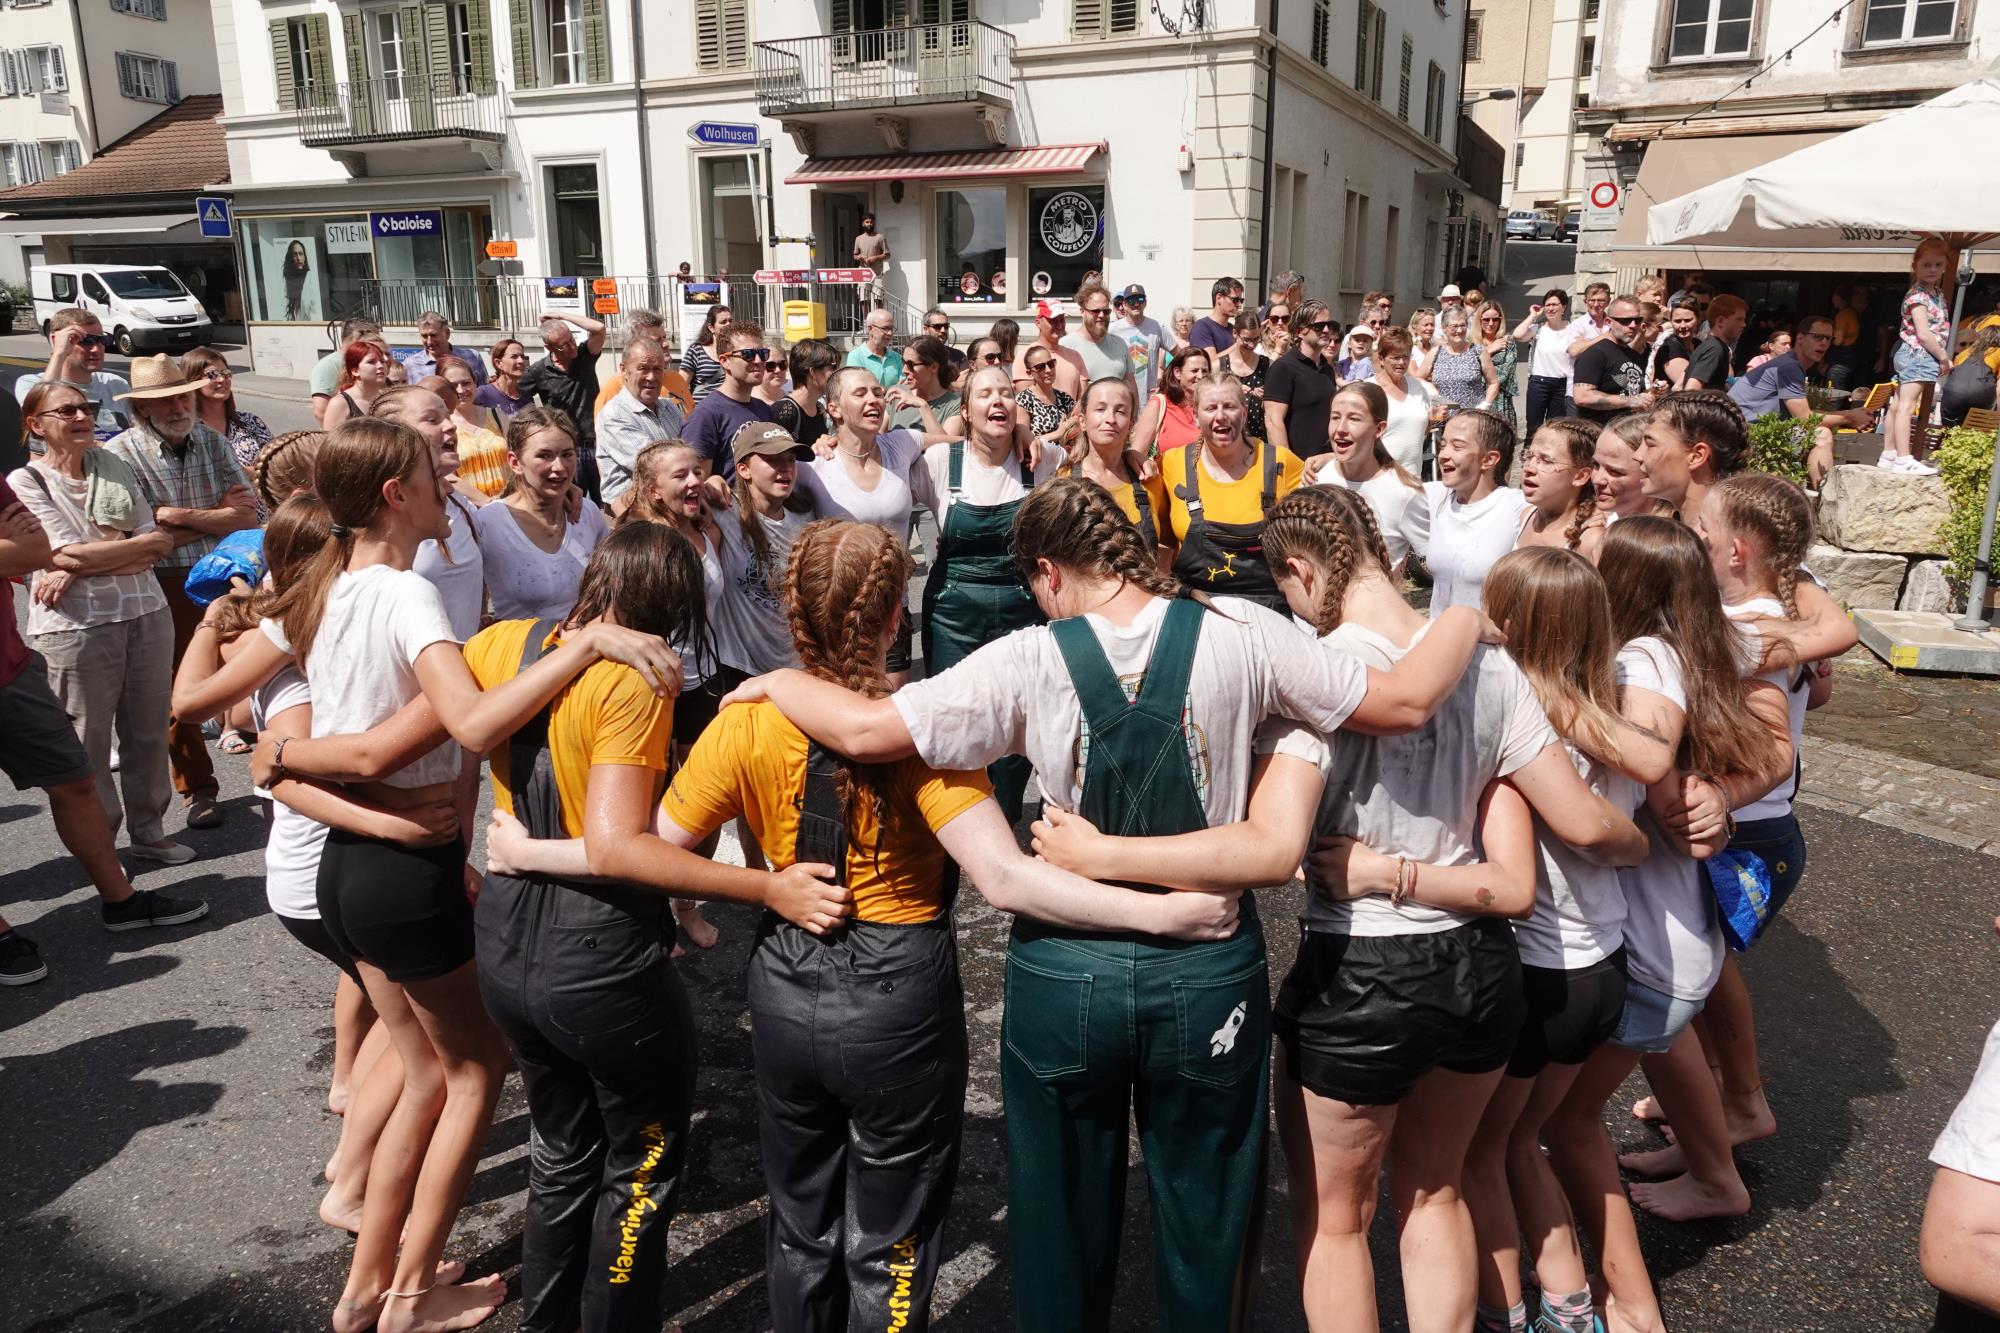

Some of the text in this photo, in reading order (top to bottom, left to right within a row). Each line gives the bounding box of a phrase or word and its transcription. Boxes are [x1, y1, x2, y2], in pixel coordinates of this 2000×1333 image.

[704, 126, 754, 141] Wolhusen
[1050, 196, 1088, 213] METRO
[390, 215, 433, 231] baloise
[328, 225, 368, 243] STYLE-IN
[491, 243, 513, 254] Ettiswil
[1047, 233, 1091, 252] COIFFEUR
